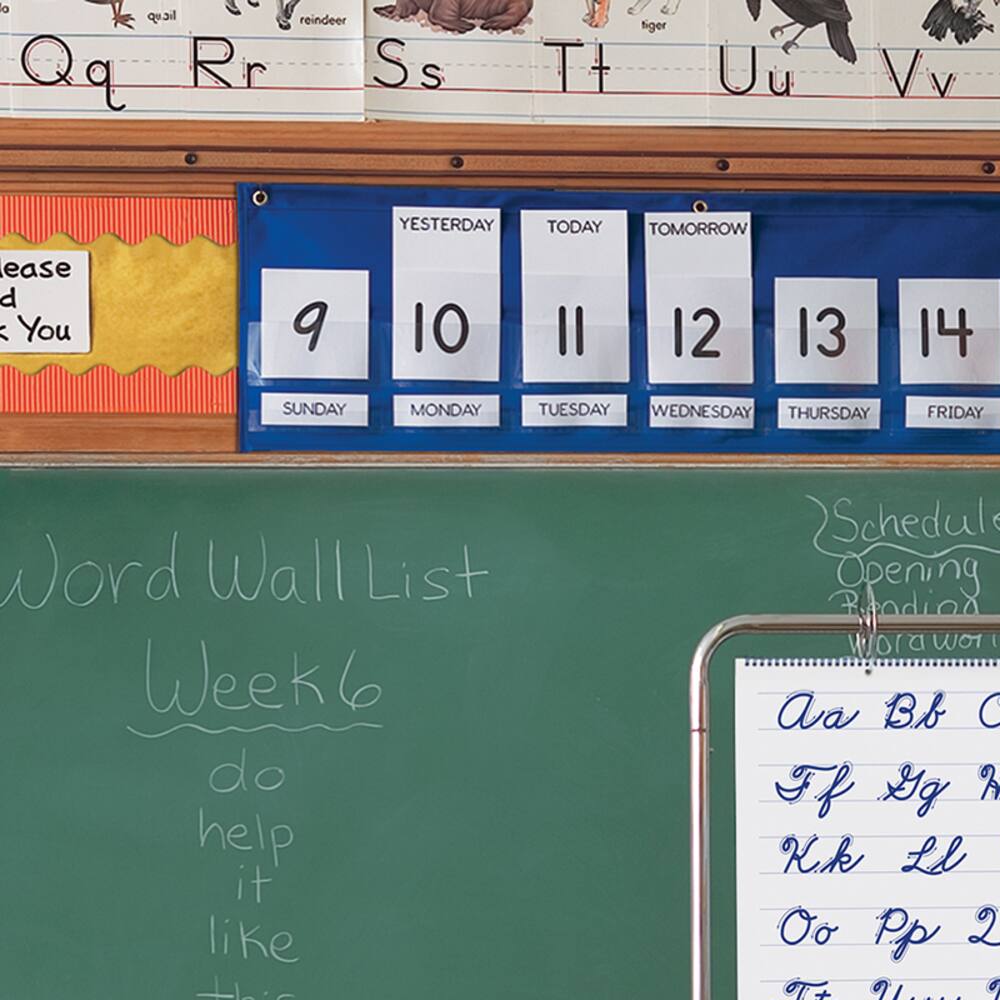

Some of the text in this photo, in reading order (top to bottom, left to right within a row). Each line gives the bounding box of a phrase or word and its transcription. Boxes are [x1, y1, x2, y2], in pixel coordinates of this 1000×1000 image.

[299, 14, 347, 26] reindeer
[641, 19, 667, 34] tiger
[193, 36, 267, 89] Rr
[373, 37, 442, 90] Ss
[543, 42, 611, 93] Tt
[719, 45, 790, 96] Uu
[882, 48, 953, 98] Vv
[399, 216, 748, 237] YESTERDAY TODAY TOMORROW
[17, 315, 71, 343] You
[294, 301, 328, 352] 9
[415, 302, 469, 354] 10
[558, 305, 584, 356] 11
[674, 307, 721, 358] 12
[800, 307, 846, 358] 13
[921, 308, 974, 358] 14
[282, 401, 347, 417] SUNDAY
[410, 402, 482, 417] MONDAY
[538, 402, 611, 417] TUESDAY
[650, 403, 753, 419] WEDNESDAY
[788, 406, 871, 421] THURSDAY
[927, 405, 984, 420] FRIDAY
[0, 530, 489, 610] Word Wall List
[836, 551, 981, 598] Opening
[145, 638, 384, 716] Week 6
[777, 692, 860, 730] Aa
[884, 692, 947, 729] Bb
[208, 747, 286, 793] do
[775, 764, 855, 819] Ff
[882, 764, 951, 818] Gg
[199, 807, 294, 868] help
[782, 836, 865, 874] Kk
[901, 835, 967, 876] Ll
[237, 864, 273, 903] it
[210, 914, 299, 963] like
[780, 908, 839, 946] Oo
[875, 907, 941, 961] Pp
